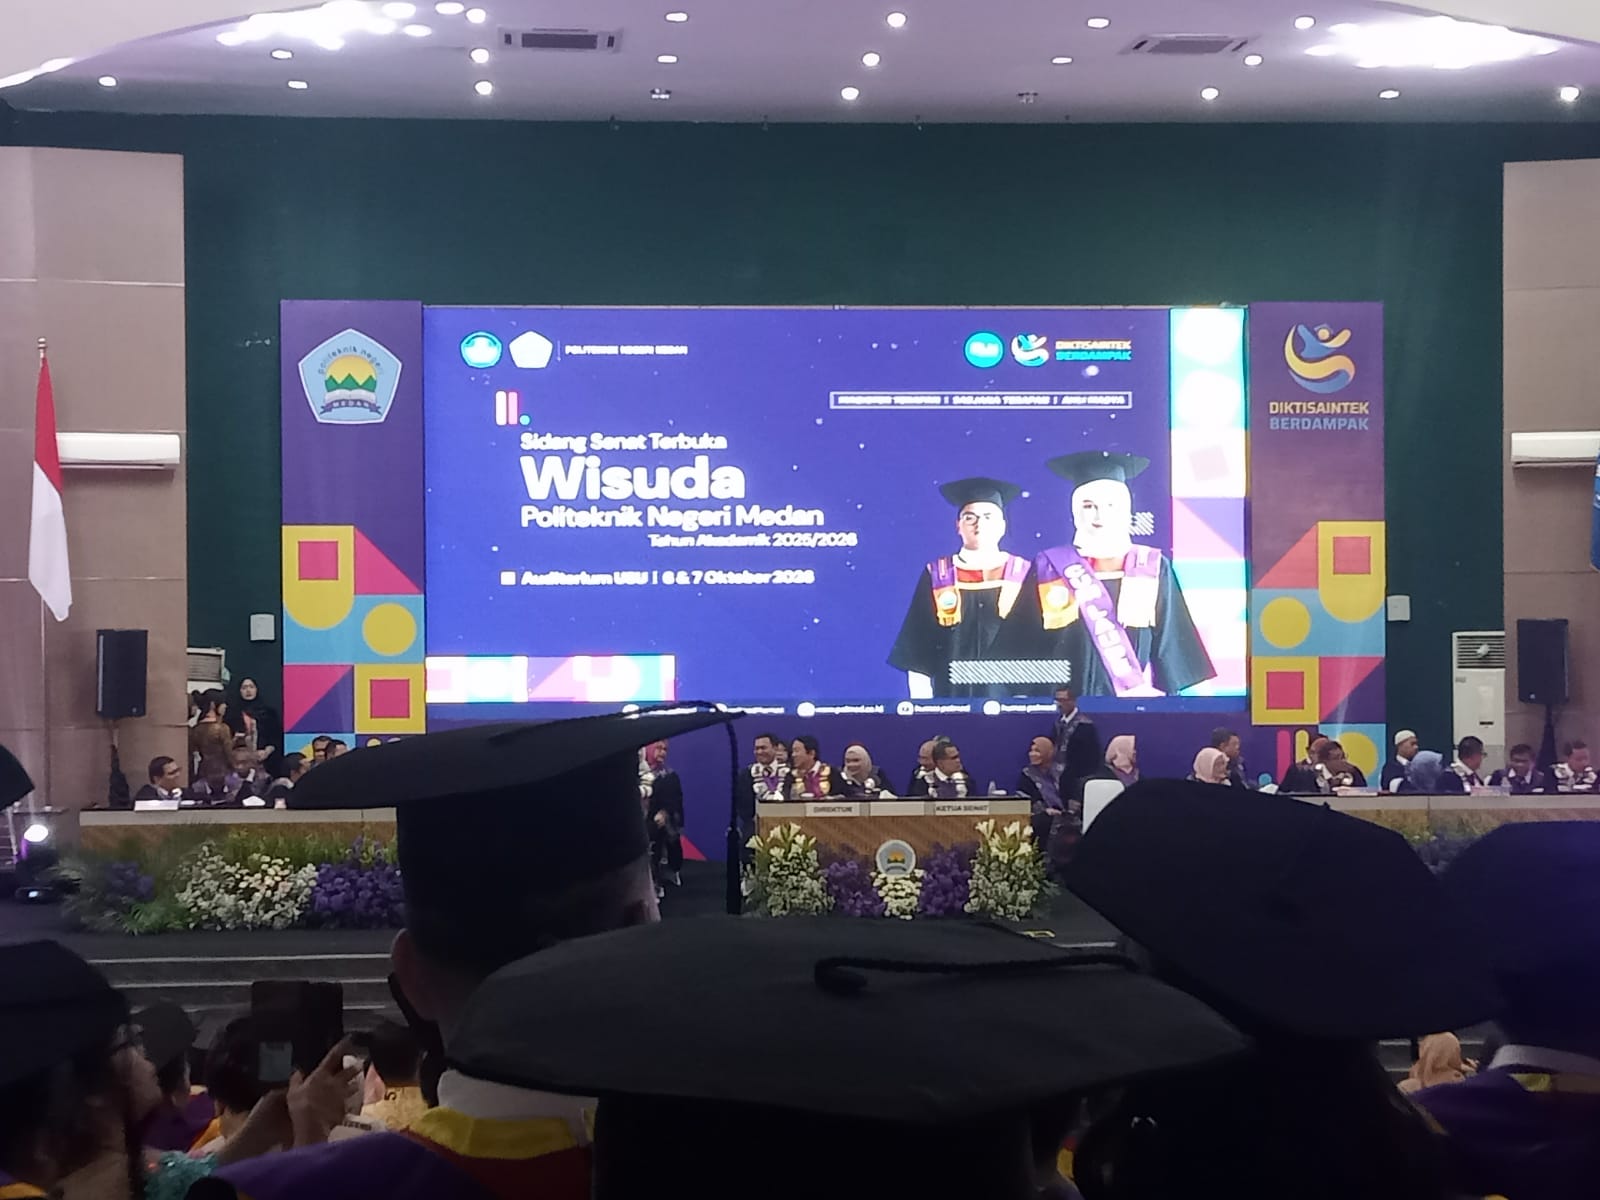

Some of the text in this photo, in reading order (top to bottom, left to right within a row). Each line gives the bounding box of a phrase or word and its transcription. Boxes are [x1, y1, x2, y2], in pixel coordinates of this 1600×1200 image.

[1269, 401, 1369, 415] DIKTISAINTEK
[1269, 417, 1369, 430] BERDAMPAK
[520, 432, 728, 453] Sidang Senat Terbuka
[519, 455, 746, 500] Wisuda
[521, 504, 825, 531] Politeknik Negeri Medan
[648, 533, 695, 548] Tahun
[696, 533, 771, 547] Akademik
[521, 571, 613, 586] Auditorium
[613, 571, 648, 585] USU
[662, 570, 675, 585] 6
[676, 570, 690, 585] &
[691, 570, 703, 585] 7
[703, 570, 772, 585] Oktober
[813, 805, 853, 814] DIREKTUR
[936, 804, 989, 813] KETUA SENAT
